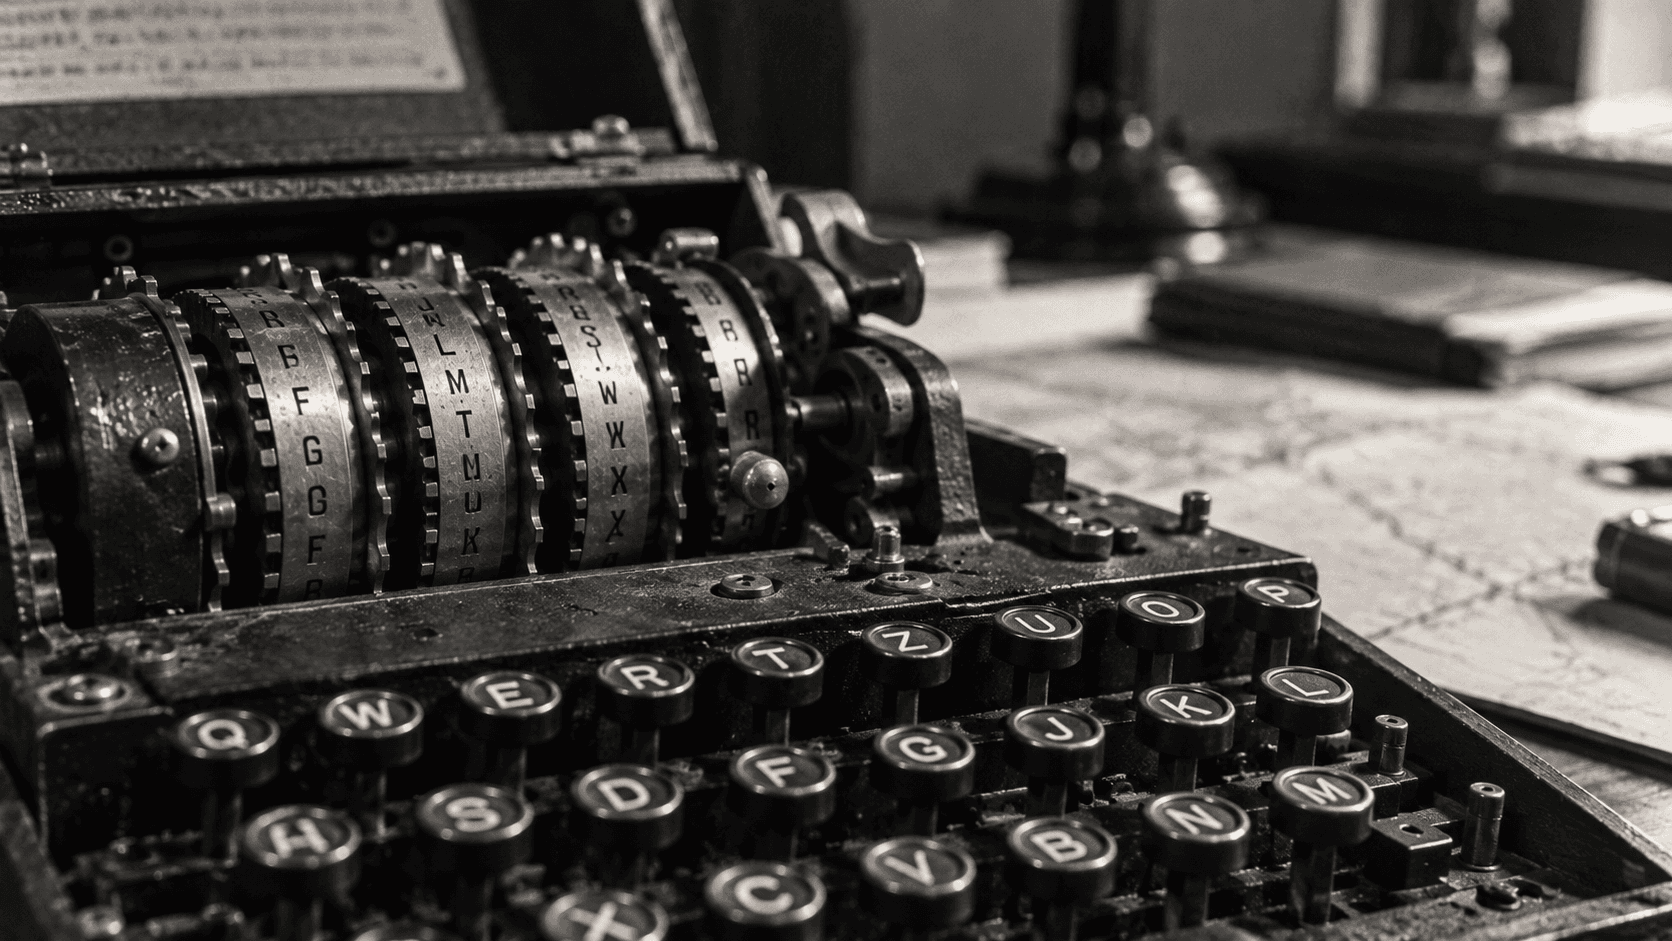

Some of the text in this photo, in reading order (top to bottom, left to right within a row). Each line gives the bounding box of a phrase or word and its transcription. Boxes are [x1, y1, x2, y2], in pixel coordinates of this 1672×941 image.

[433, 333, 456, 356] L
[445, 368, 469, 395] M
[733, 358, 753, 386] R
[291, 386, 310, 415] F
[580, 325, 602, 348] S
[598, 380, 618, 404] W
[610, 465, 628, 496] X
[455, 410, 473, 438] T
[303, 435, 323, 466] G
[308, 485, 327, 517] G
[308, 534, 326, 564] F
[197, 718, 249, 750] Q
[337, 699, 393, 731] W
[486, 681, 535, 710] E
[619, 665, 671, 690] R
[751, 646, 790, 671] T
[881, 630, 930, 654] Z
[1013, 614, 1057, 635] U
[1257, 585, 1291, 605] P
[446, 797, 501, 832] S
[597, 777, 651, 812] D
[755, 756, 796, 788] F
[898, 736, 949, 764] G
[1045, 716, 1075, 742] J
[1159, 694, 1215, 720] K
[1281, 678, 1331, 698] L
[733, 875, 795, 915] C
[884, 850, 935, 886] V
[1031, 830, 1089, 864] B
[1171, 803, 1220, 836] N
[1292, 777, 1345, 805] M
